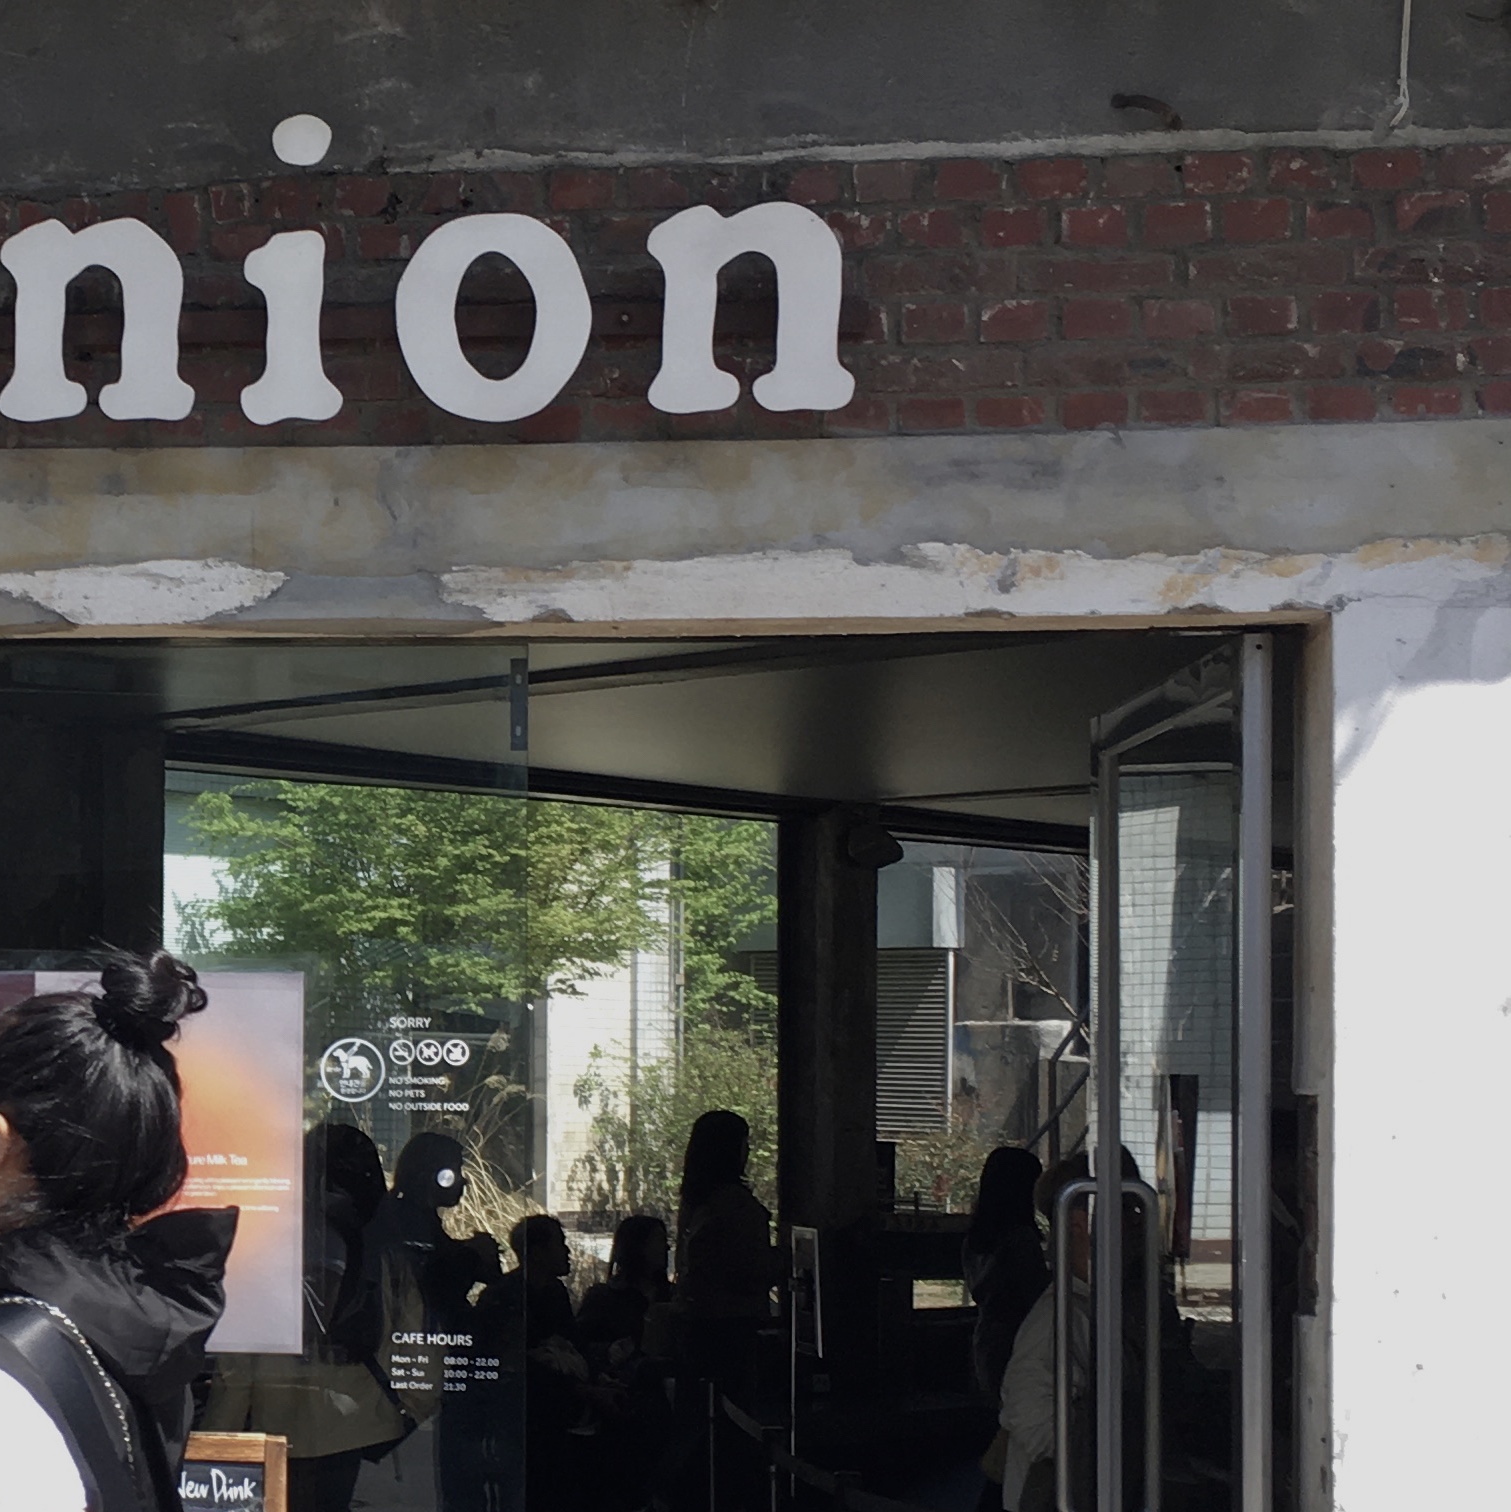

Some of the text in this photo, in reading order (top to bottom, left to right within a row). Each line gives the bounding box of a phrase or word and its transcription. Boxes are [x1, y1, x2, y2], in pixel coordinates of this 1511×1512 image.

[389, 1017, 432, 1029] SORRY
[388, 1076, 447, 1085] NO SMOKING
[388, 1089, 426, 1098] NO PETS
[388, 1102, 470, 1112] NO OUTSIDE FOOD
[391, 1332, 473, 1347] CAFE HOURS
[391, 1354, 411, 1364] Mon
[417, 1355, 429, 1364] Fri
[391, 1367, 405, 1377] Sat
[411, 1368, 425, 1377] Sun
[390, 1380, 408, 1390] Last
[408, 1381, 433, 1390] Order
[210, 1467, 257, 1503] Drink
